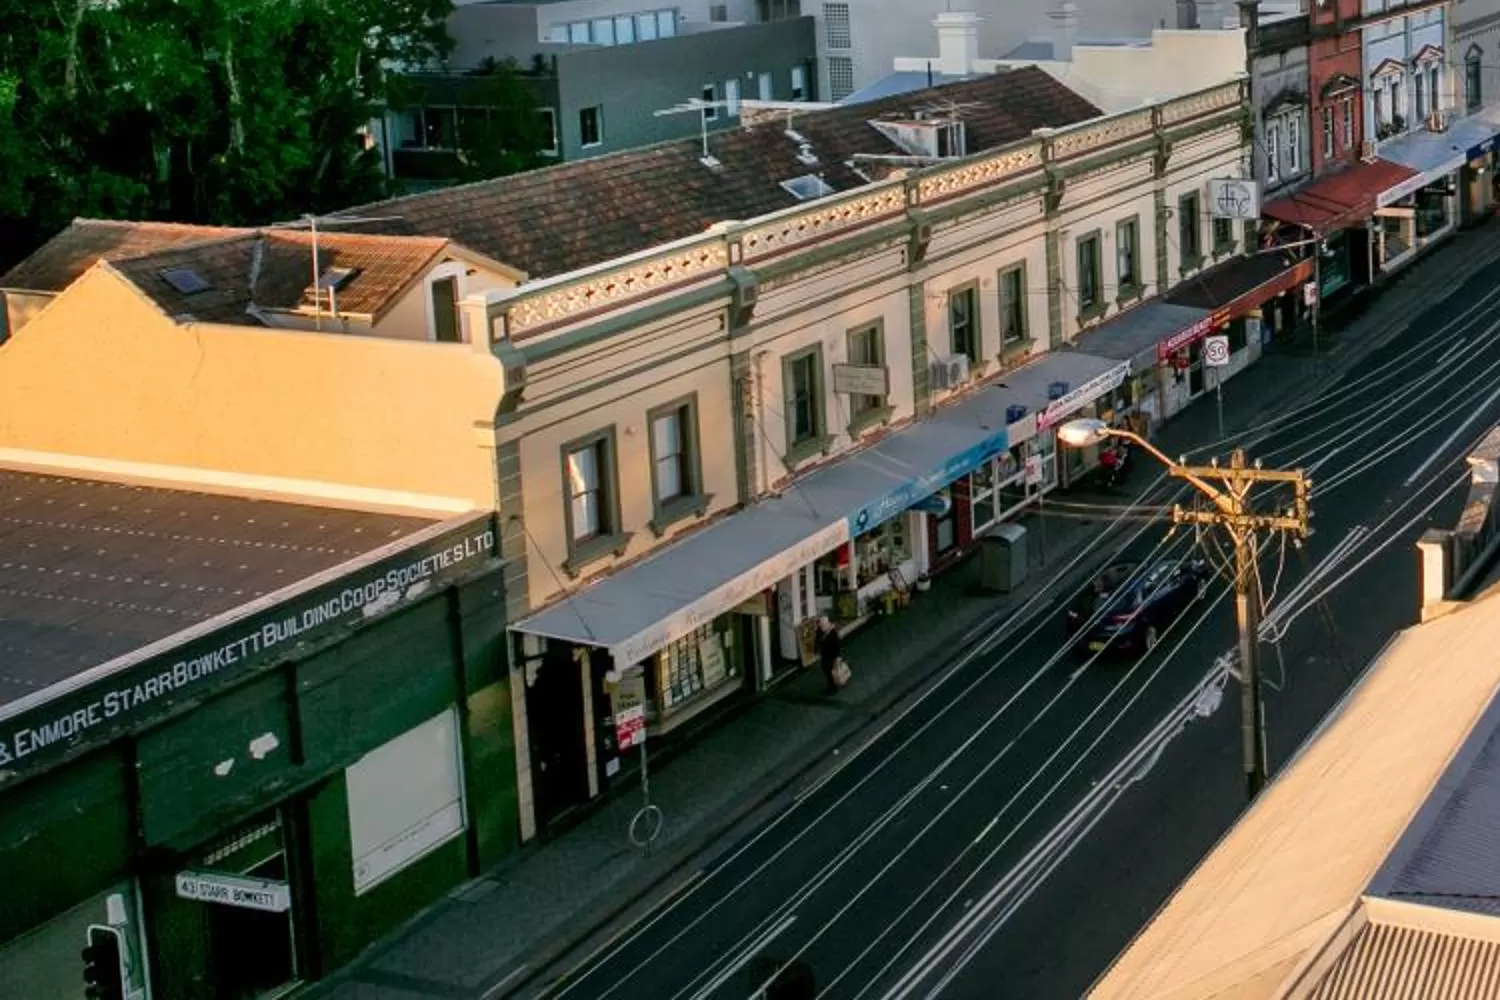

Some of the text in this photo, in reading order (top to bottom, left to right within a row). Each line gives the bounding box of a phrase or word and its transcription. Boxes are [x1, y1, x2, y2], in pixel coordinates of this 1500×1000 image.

[1209, 345, 1225, 358] 50
[14, 701, 104, 758] ENMORE
[103, 672, 174, 718] STARR
[172, 631, 262, 689] BOWKETT
[385, 543, 465, 592] SOCIETIES
[464, 530, 495, 557] LTD
[199, 884, 229, 898] STARR
[232, 889, 276, 906] BOWKETT
